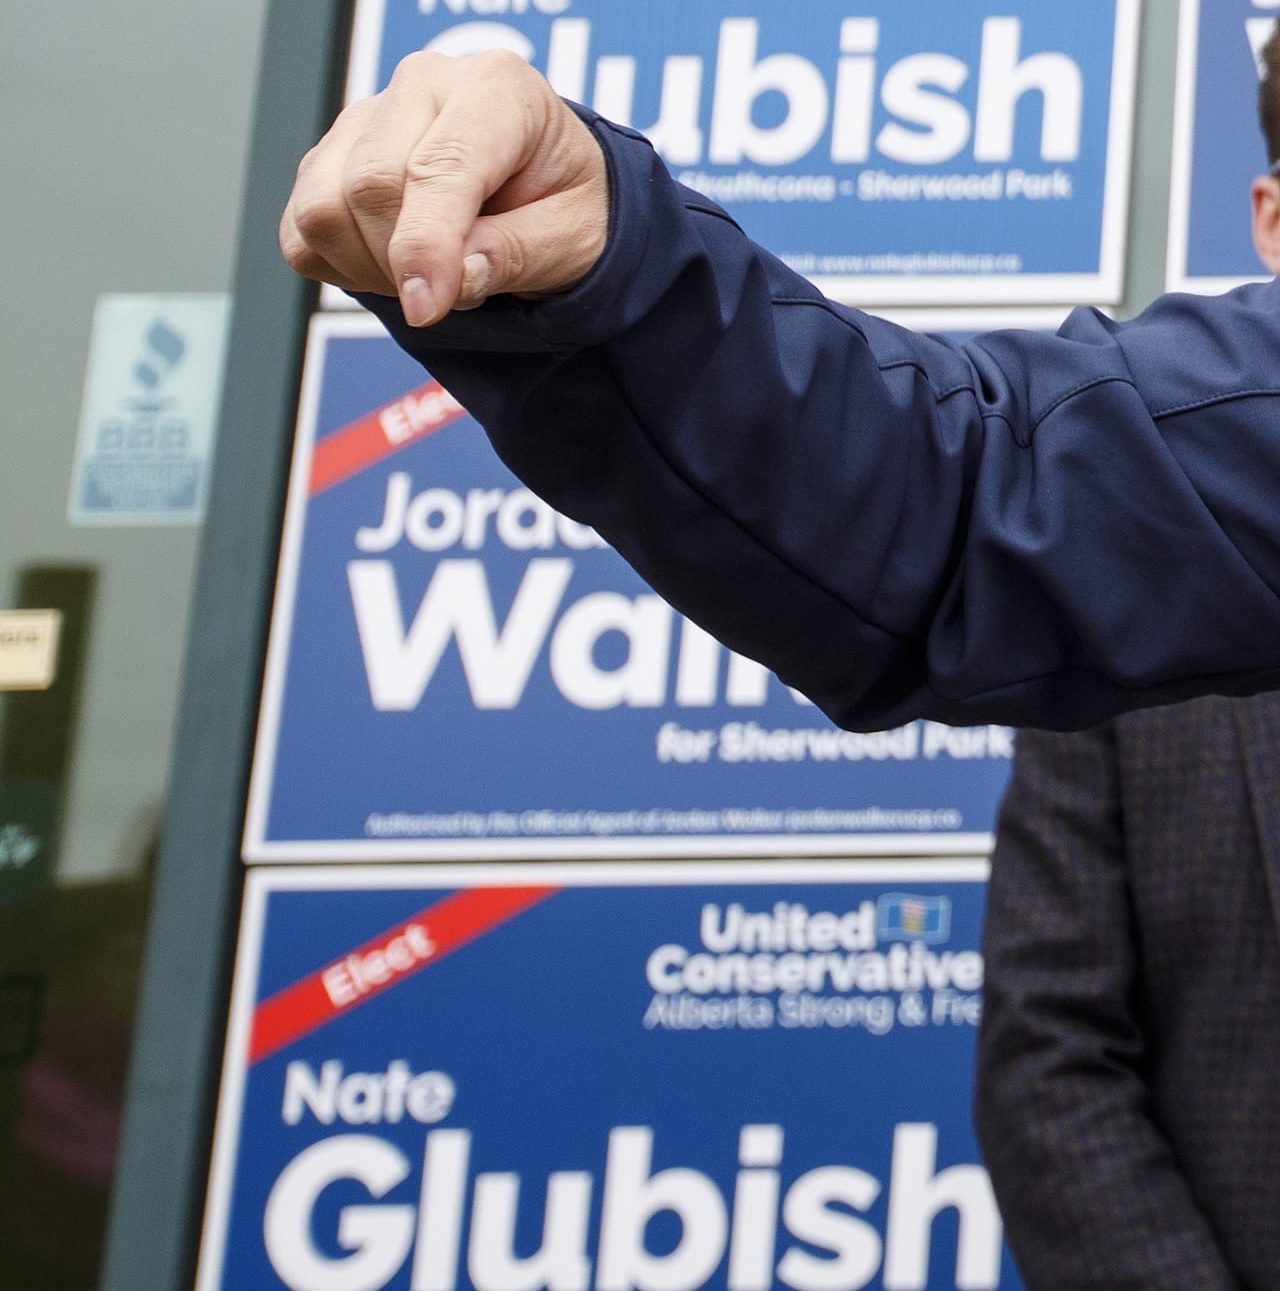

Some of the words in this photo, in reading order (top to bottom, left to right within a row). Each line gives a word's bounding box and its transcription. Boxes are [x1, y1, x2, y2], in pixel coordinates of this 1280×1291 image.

[424, 16, 1083, 168] lubish
[858, 170, 1014, 201] Sherwood
[1018, 169, 1072, 199] Park
[656, 722, 714, 763] for
[718, 722, 918, 762] Sherwood
[923, 720, 1015, 761] Park
[700, 901, 876, 953] United
[322, 922, 436, 1010] Elect
[643, 994, 774, 1029] Alberta
[778, 992, 895, 1035] Strong
[898, 992, 926, 1025] &
[281, 1060, 455, 1125] Nate
[263, 1121, 1003, 1291] Glubish
